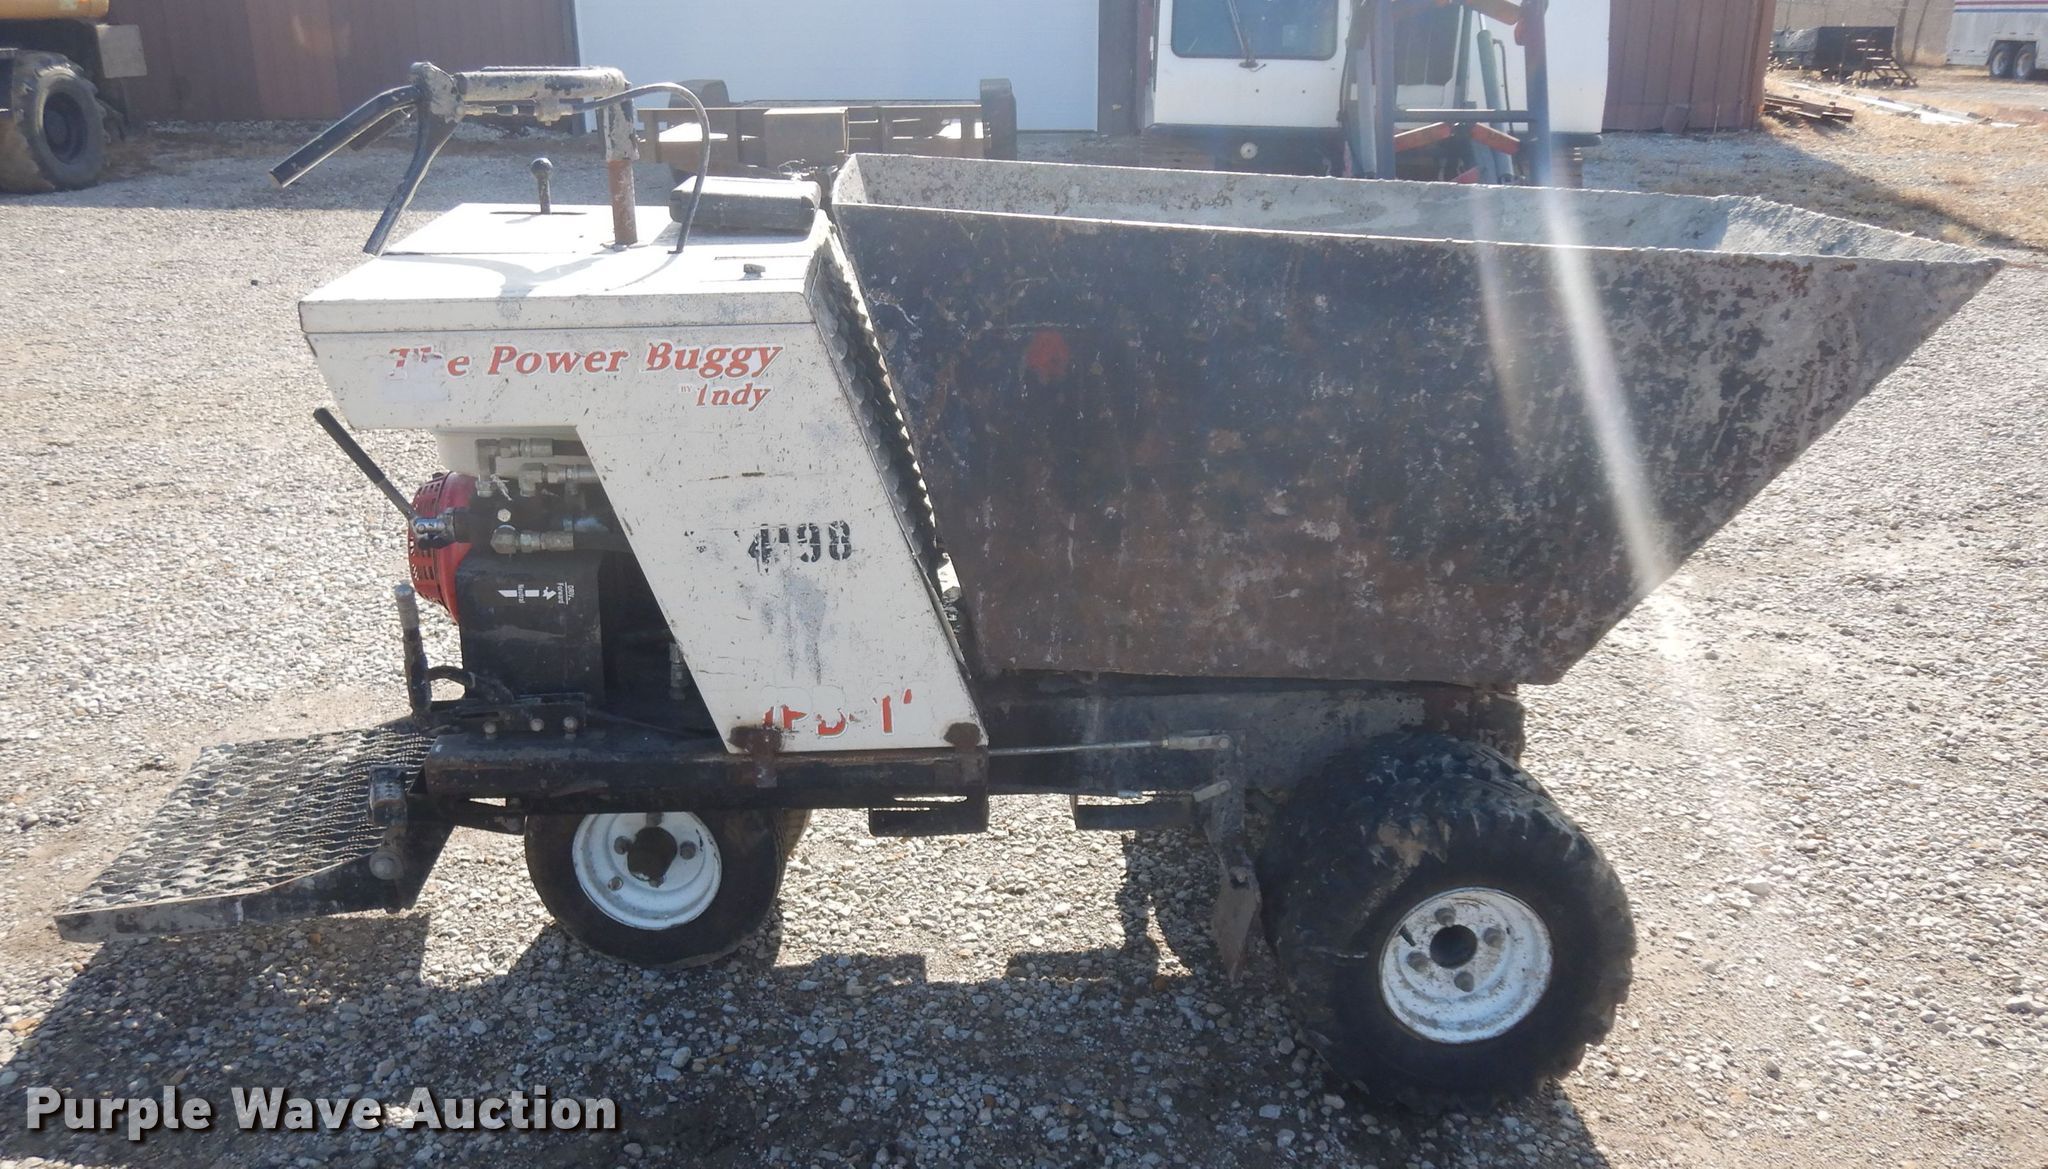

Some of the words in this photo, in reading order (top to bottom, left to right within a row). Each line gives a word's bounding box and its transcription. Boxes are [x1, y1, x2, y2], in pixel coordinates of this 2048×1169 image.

[487, 345, 629, 376] Power
[646, 342, 784, 379] Buggy
[696, 382, 772, 412] Indy
[518, 584, 526, 604] Neutral
[557, 582, 565, 604] Forward
